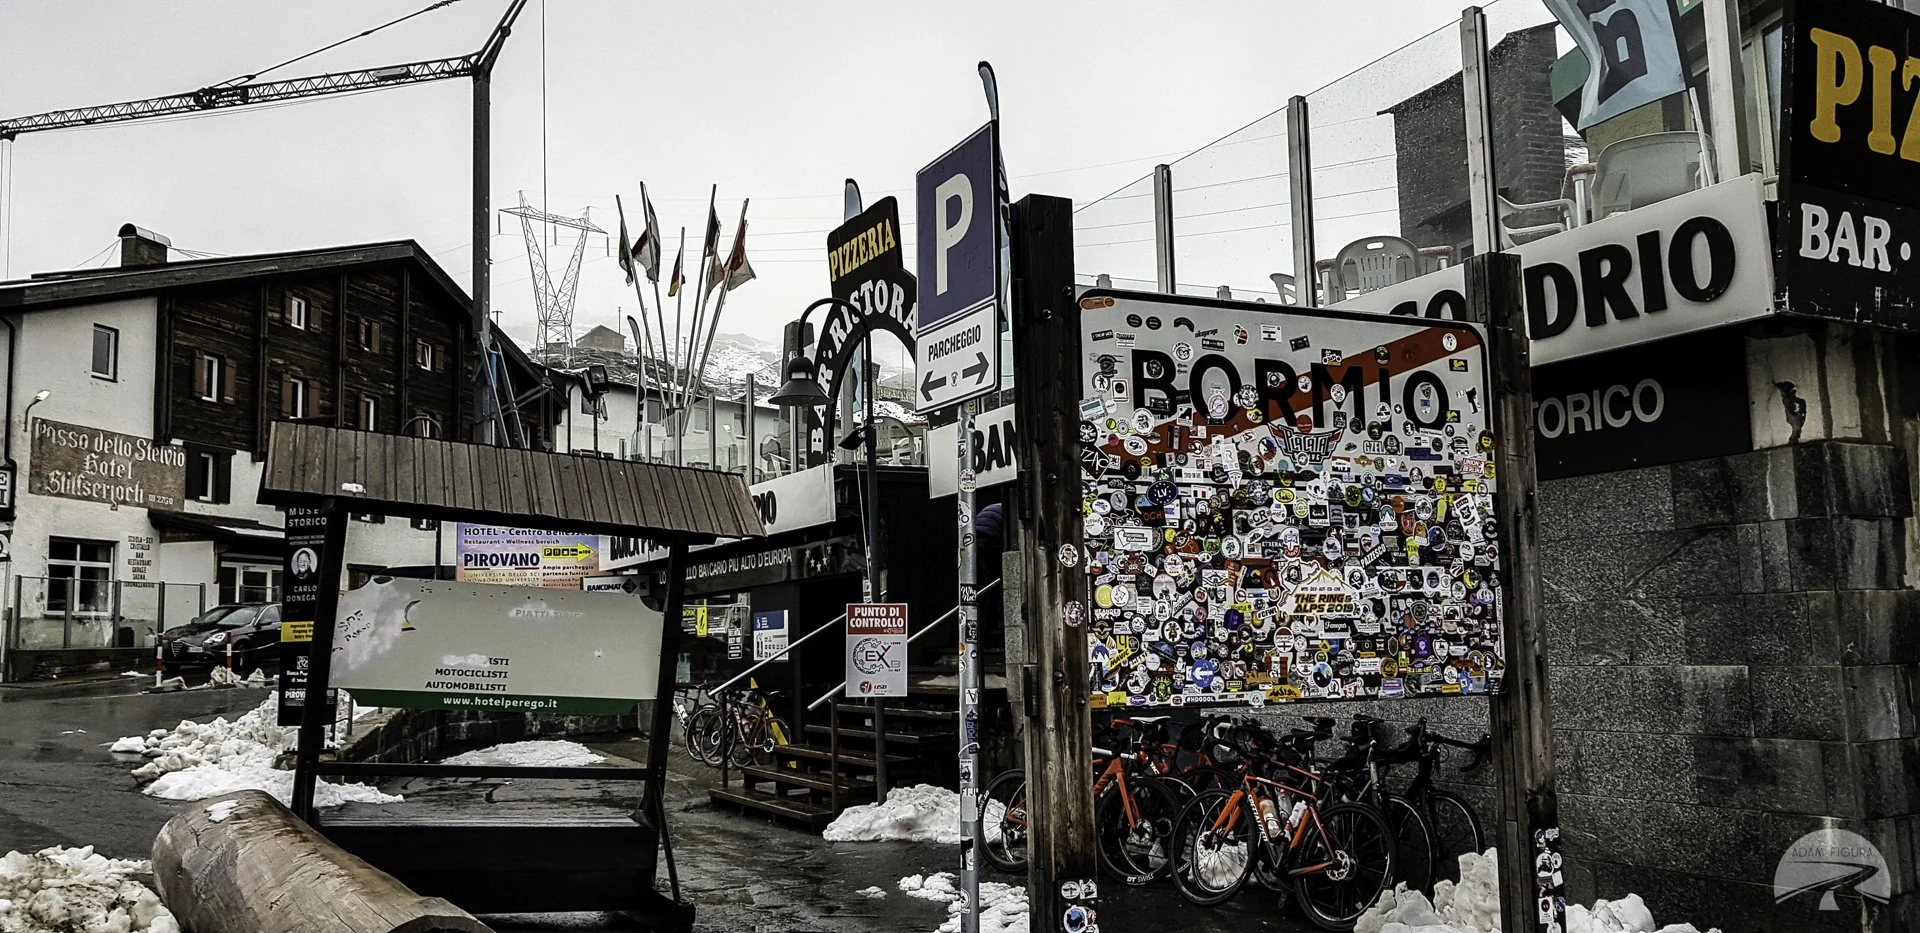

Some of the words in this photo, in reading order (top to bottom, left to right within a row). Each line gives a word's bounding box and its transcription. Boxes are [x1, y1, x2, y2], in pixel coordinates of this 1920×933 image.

[936, 173, 974, 297] P
[1800, 203, 1891, 272] BAR
[829, 217, 896, 283] PIZZERIA
[1523, 216, 1736, 341] DRIO
[928, 324, 982, 363] PARCHEGGIO
[1131, 349, 1450, 432] BORMIO
[1532, 378, 1665, 440] ORICO
[94, 431, 132, 457] dello
[134, 438, 185, 467] Stelvio
[83, 452, 133, 479] Hotel
[1157, 488, 1168, 498] LV
[289, 508, 319, 516] MUSE
[288, 517, 327, 527] STORICO
[464, 528, 499, 536] HOTEL
[508, 528, 543, 536] Centro
[464, 553, 540, 567] PIROVANO
[1360, 544, 1387, 568] PAZZESCO
[698, 560, 727, 578] BANCARIO
[741, 554, 756, 571] ALTO
[758, 547, 793, 568] D'EUROPA
[293, 585, 318, 593] CARLO
[586, 583, 622, 592] BANCOMAT
[286, 594, 317, 602] DONEGA
[1295, 594, 1318, 603] THE
[1318, 594, 1344, 603] RING
[515, 609, 549, 617] PIATTI
[854, 607, 887, 617] PUNTO
[889, 607, 900, 617] DI
[1294, 604, 1325, 613] ALPS
[1326, 604, 1354, 613] 2019
[849, 618, 904, 628] CONTROLLO
[1109, 649, 1130, 667] MAVIC
[435, 668, 508, 679] MOTOCICLISTI
[425, 681, 507, 691] AUTOMOBILISTI
[443, 697, 557, 710] www.hotelperego.it
[1137, 873, 1155, 883] SWISS
